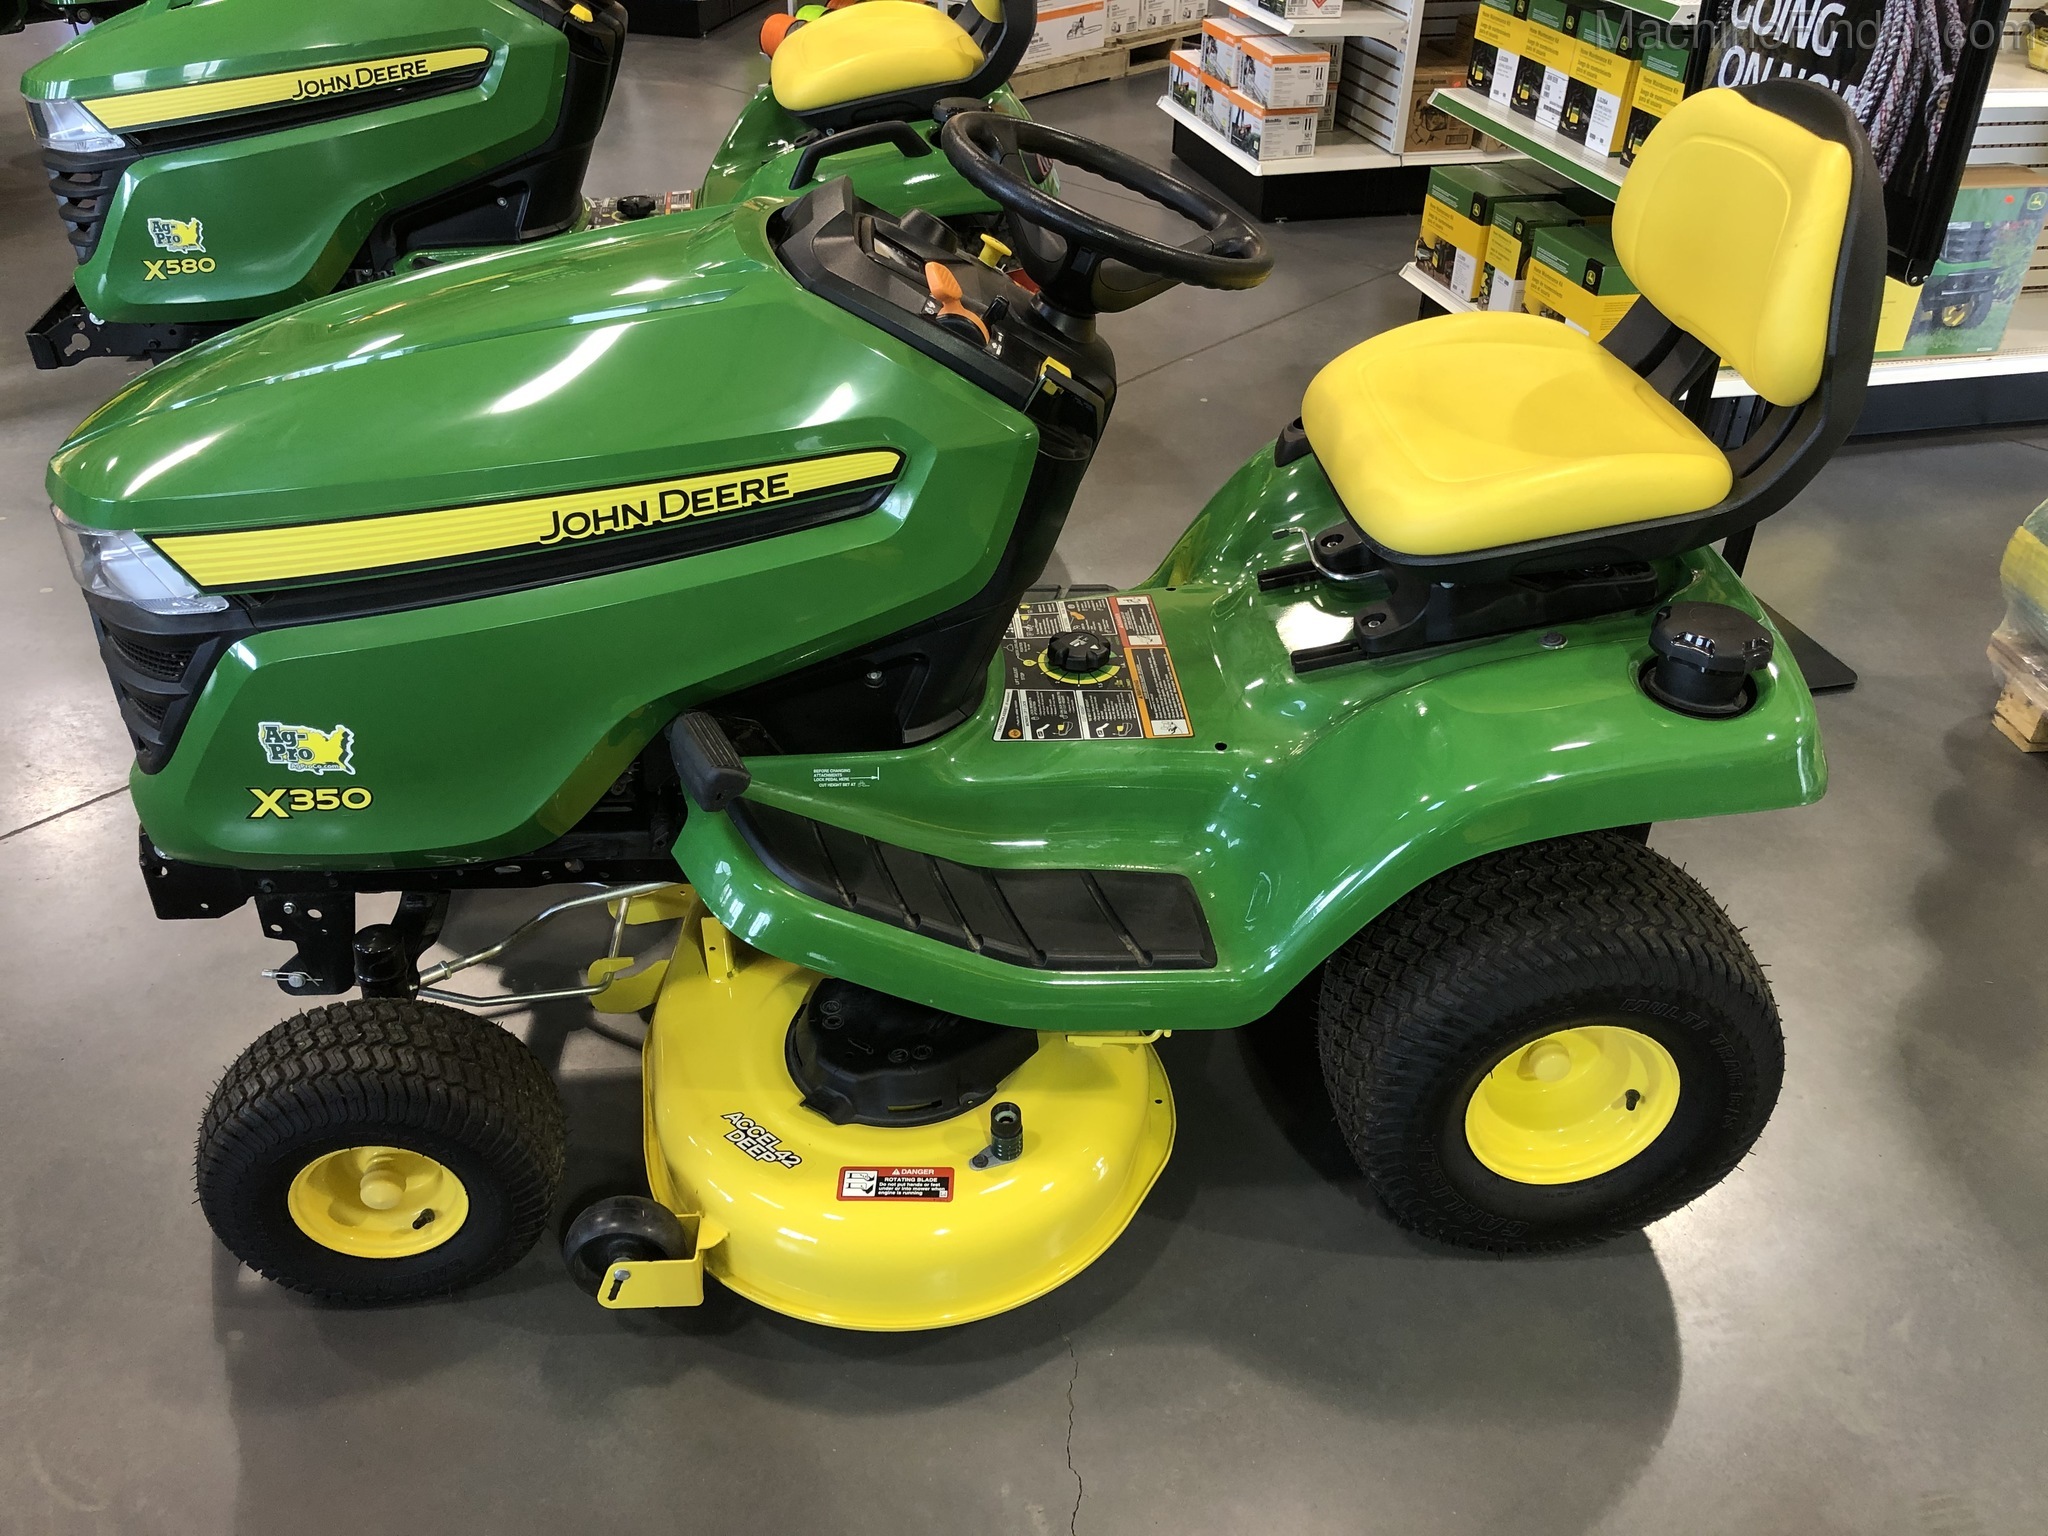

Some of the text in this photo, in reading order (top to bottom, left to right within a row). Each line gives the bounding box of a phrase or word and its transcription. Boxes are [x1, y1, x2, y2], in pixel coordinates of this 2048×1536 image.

[293, 59, 428, 99] JOHN DEERE
[1717, 45, 1774, 88] ON
[156, 233, 180, 244] Pro
[142, 257, 216, 281] X580
[540, 472, 790, 541] JOHN DEERE
[264, 726, 306, 747] Ag-
[269, 744, 313, 760] Pro
[246, 786, 373, 819] X350
[1619, 998, 1710, 1031] MULTI
[721, 1112, 782, 1153] ACCEL
[723, 1129, 802, 1169] DEEP 42
